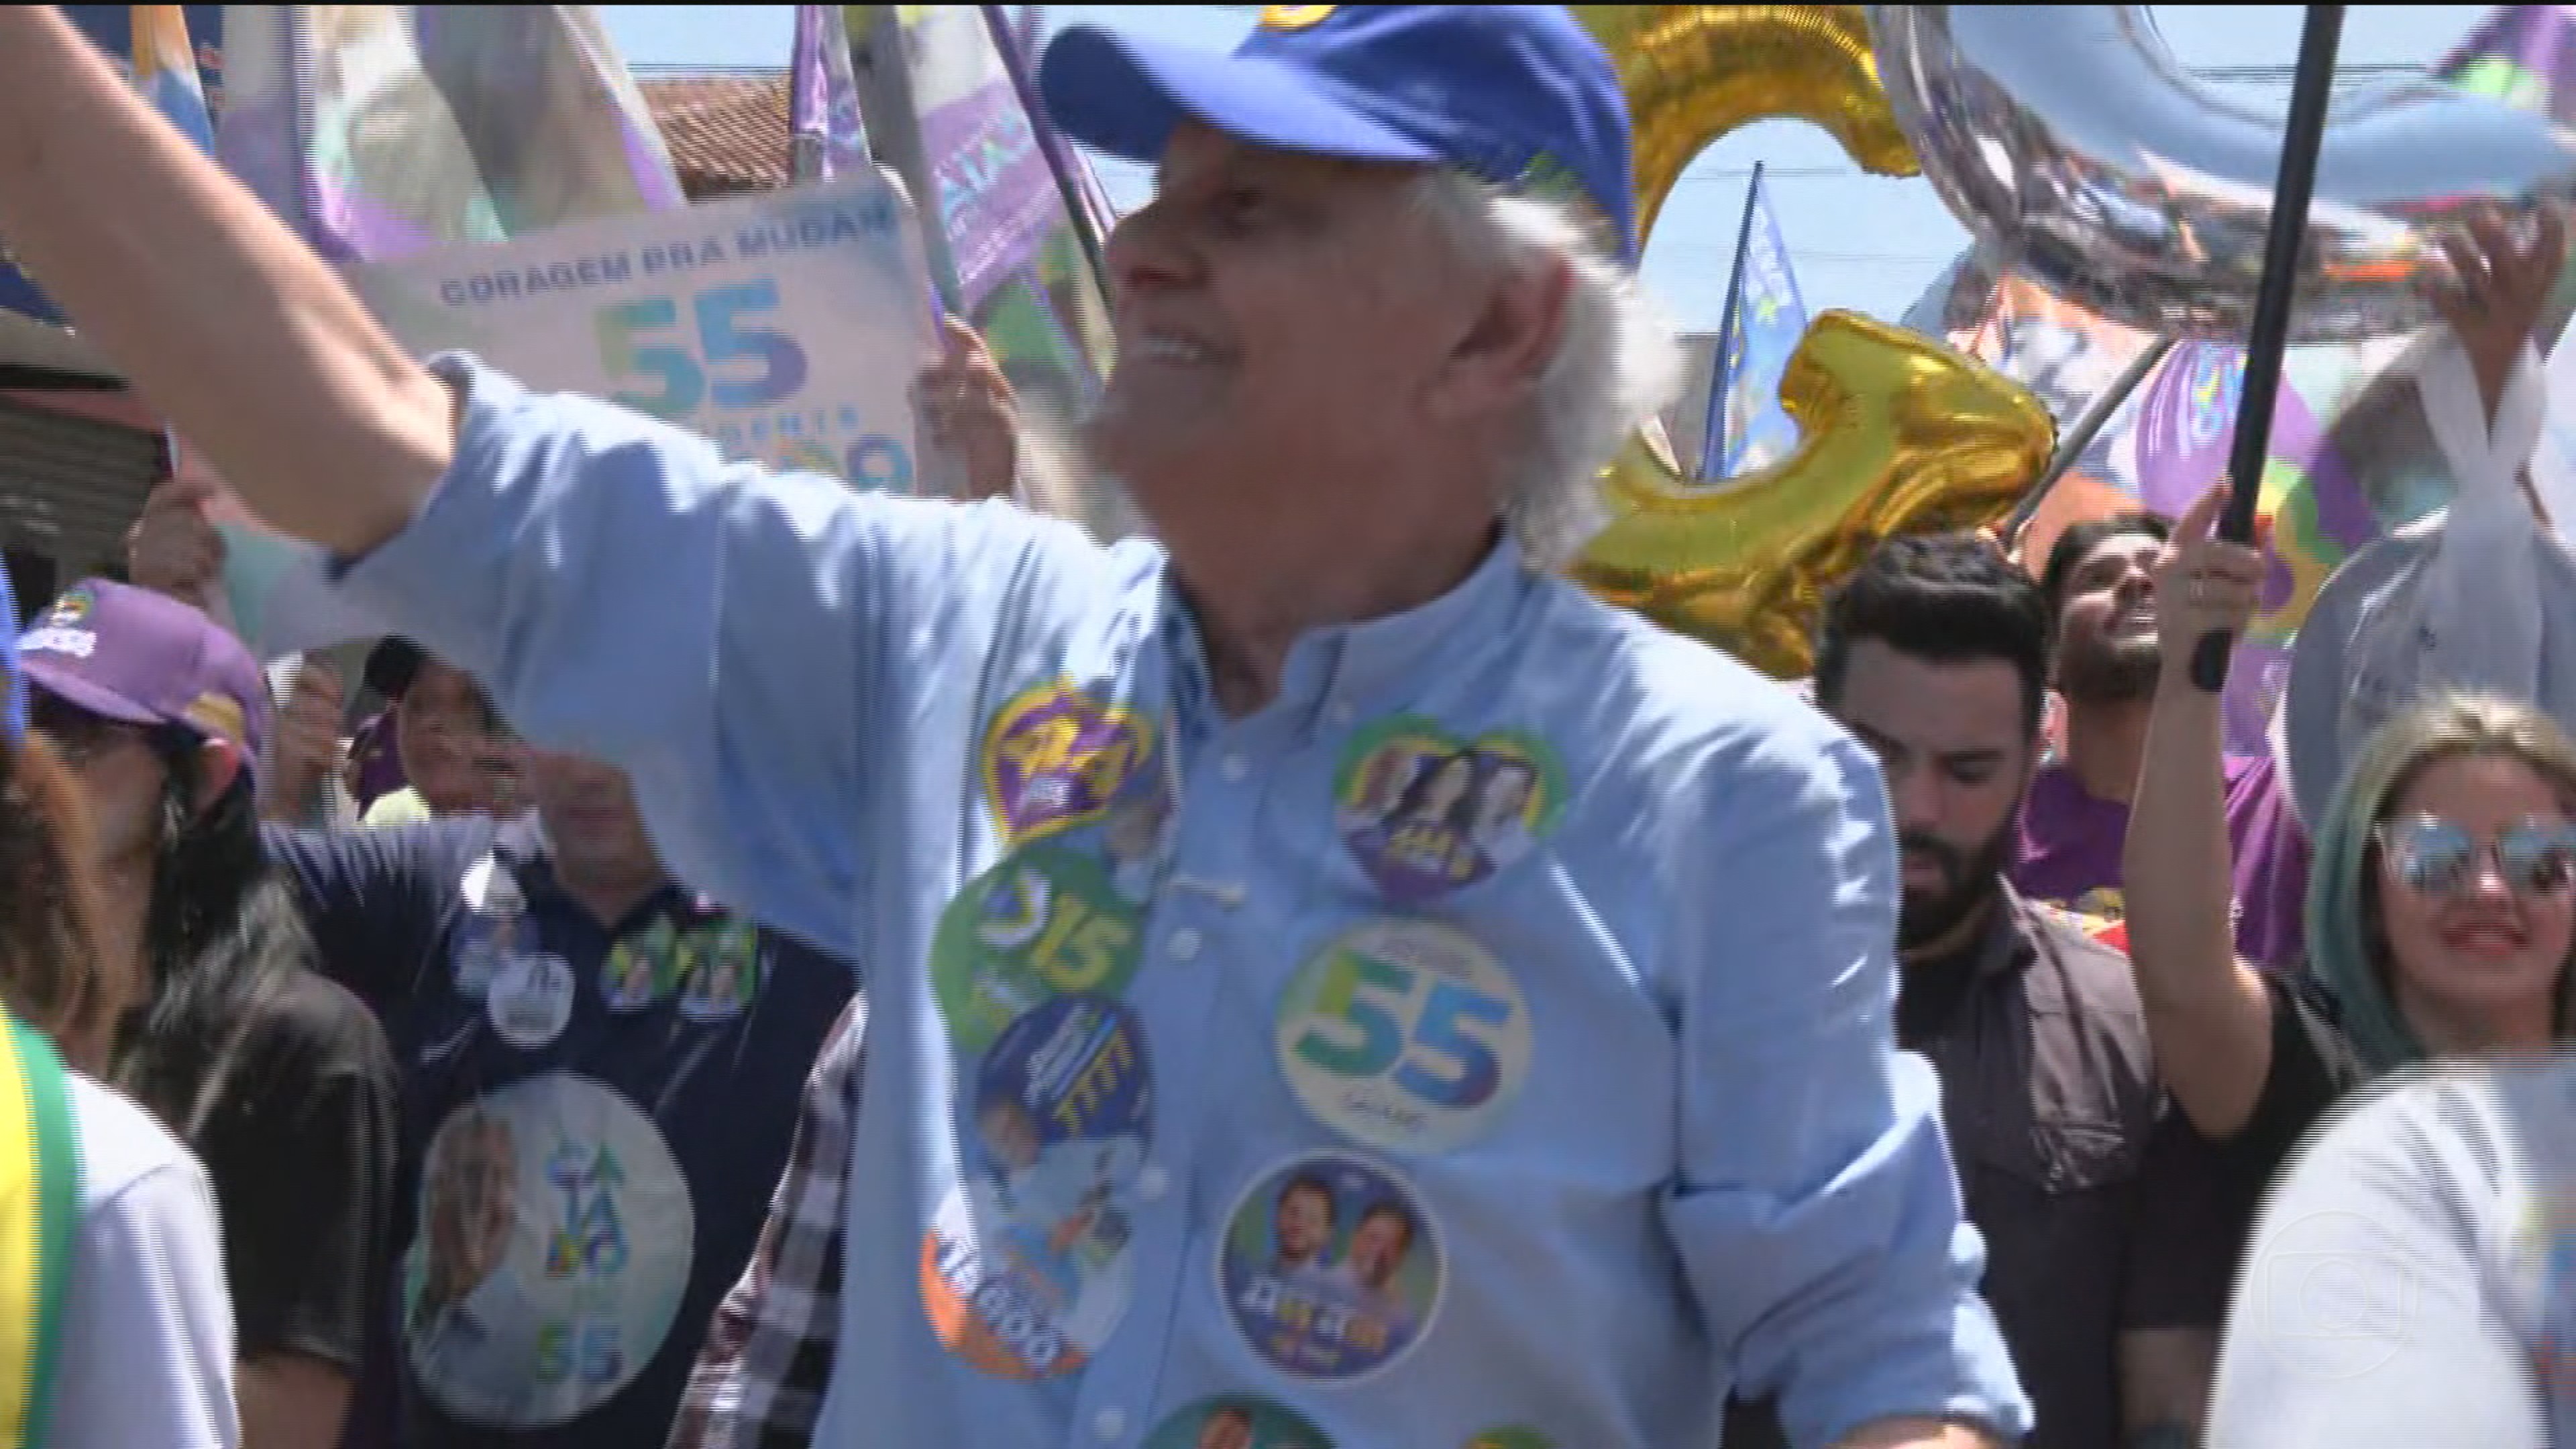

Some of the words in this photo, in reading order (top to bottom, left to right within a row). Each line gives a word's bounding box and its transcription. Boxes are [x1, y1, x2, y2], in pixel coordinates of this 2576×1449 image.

[440, 252, 631, 307] CORAGEM
[642, 236, 726, 276] PRA
[593, 276, 807, 419] 55
[1031, 895, 1132, 988] 15
[1294, 944, 1513, 1109] 55
[537, 1321, 625, 1385] 55
